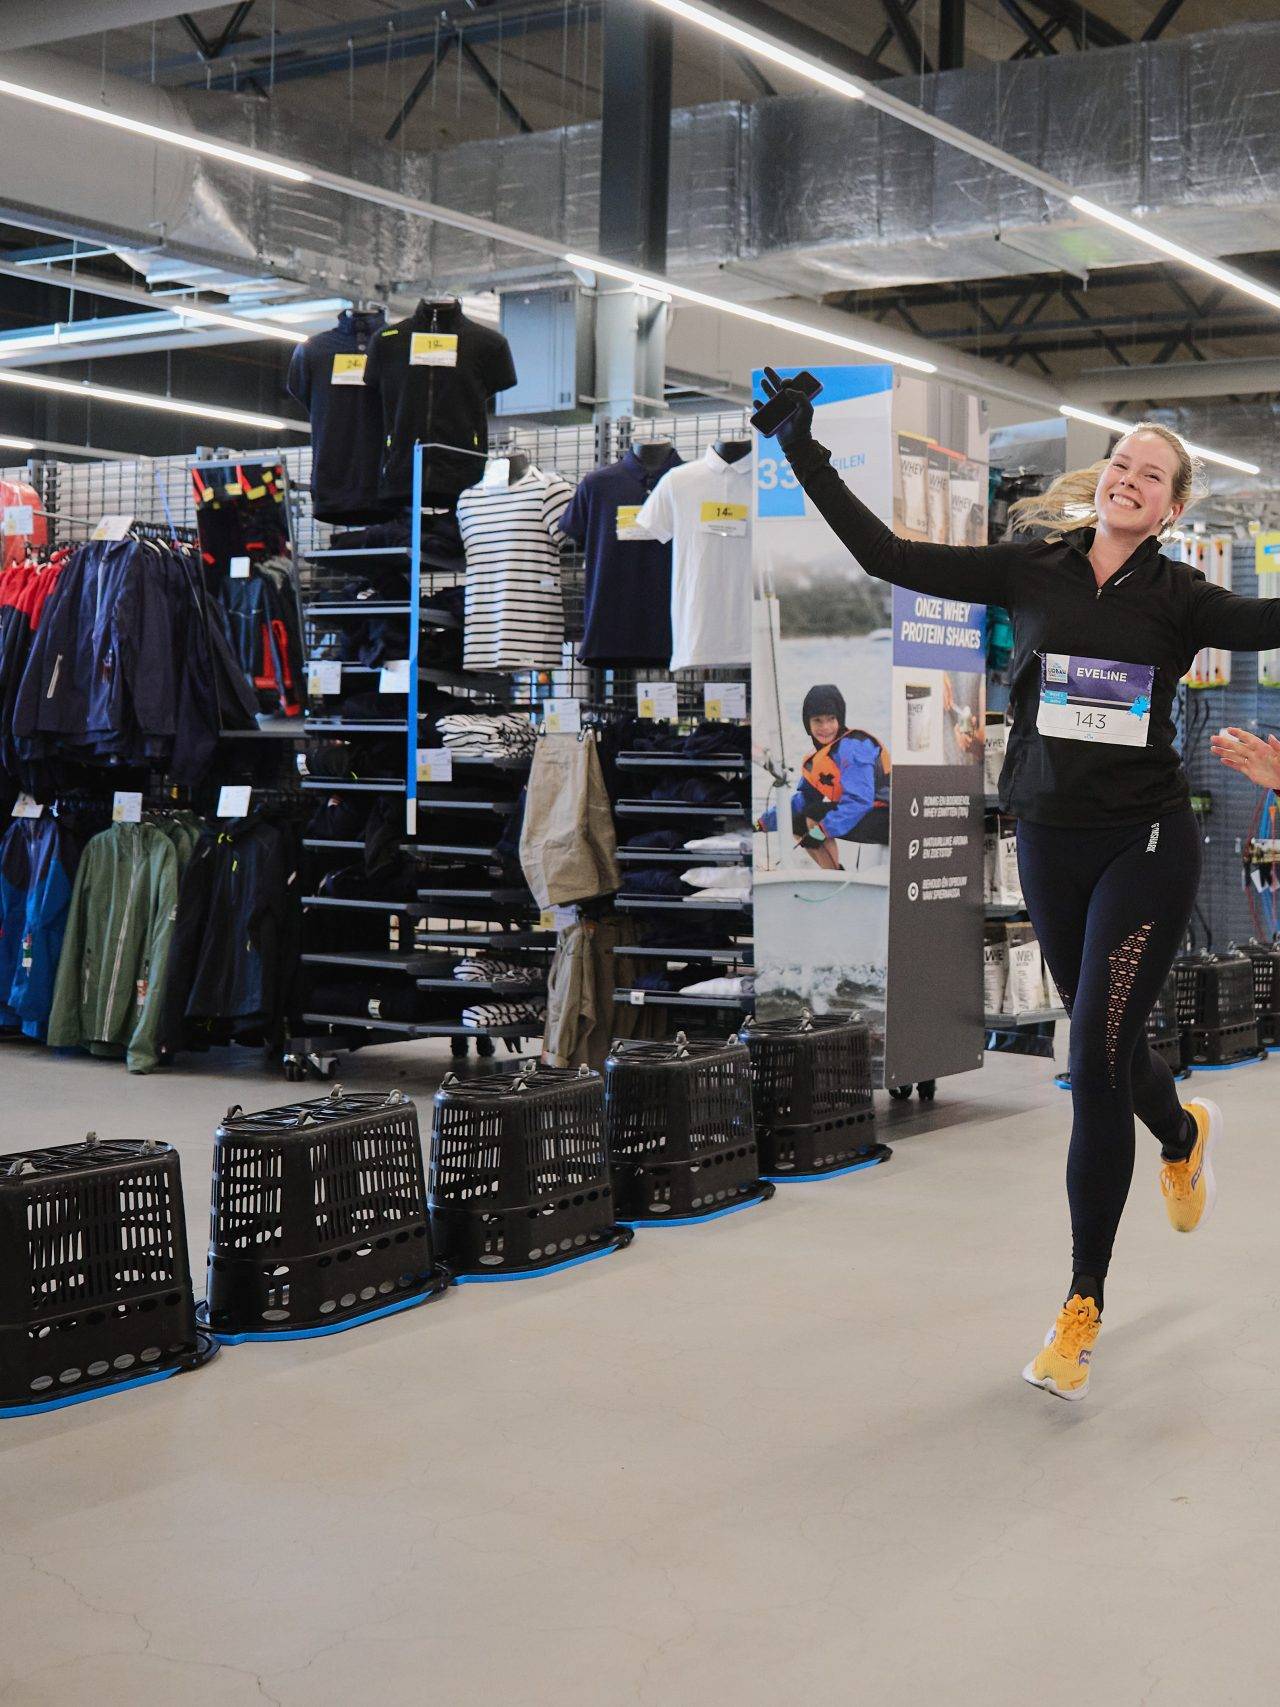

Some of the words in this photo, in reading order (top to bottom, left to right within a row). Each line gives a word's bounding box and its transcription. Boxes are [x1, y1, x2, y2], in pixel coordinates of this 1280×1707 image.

[832, 453, 866, 471] EILEN
[903, 460, 926, 475] WHEY
[929, 473, 947, 490] WHE
[915, 597, 942, 619] ONZE
[942, 600, 971, 623] WHEY
[901, 621, 945, 645] PROTEIN
[945, 625, 981, 650] SHAKES
[1076, 667, 1128, 683] EVELINE
[1075, 711, 1107, 730] 143
